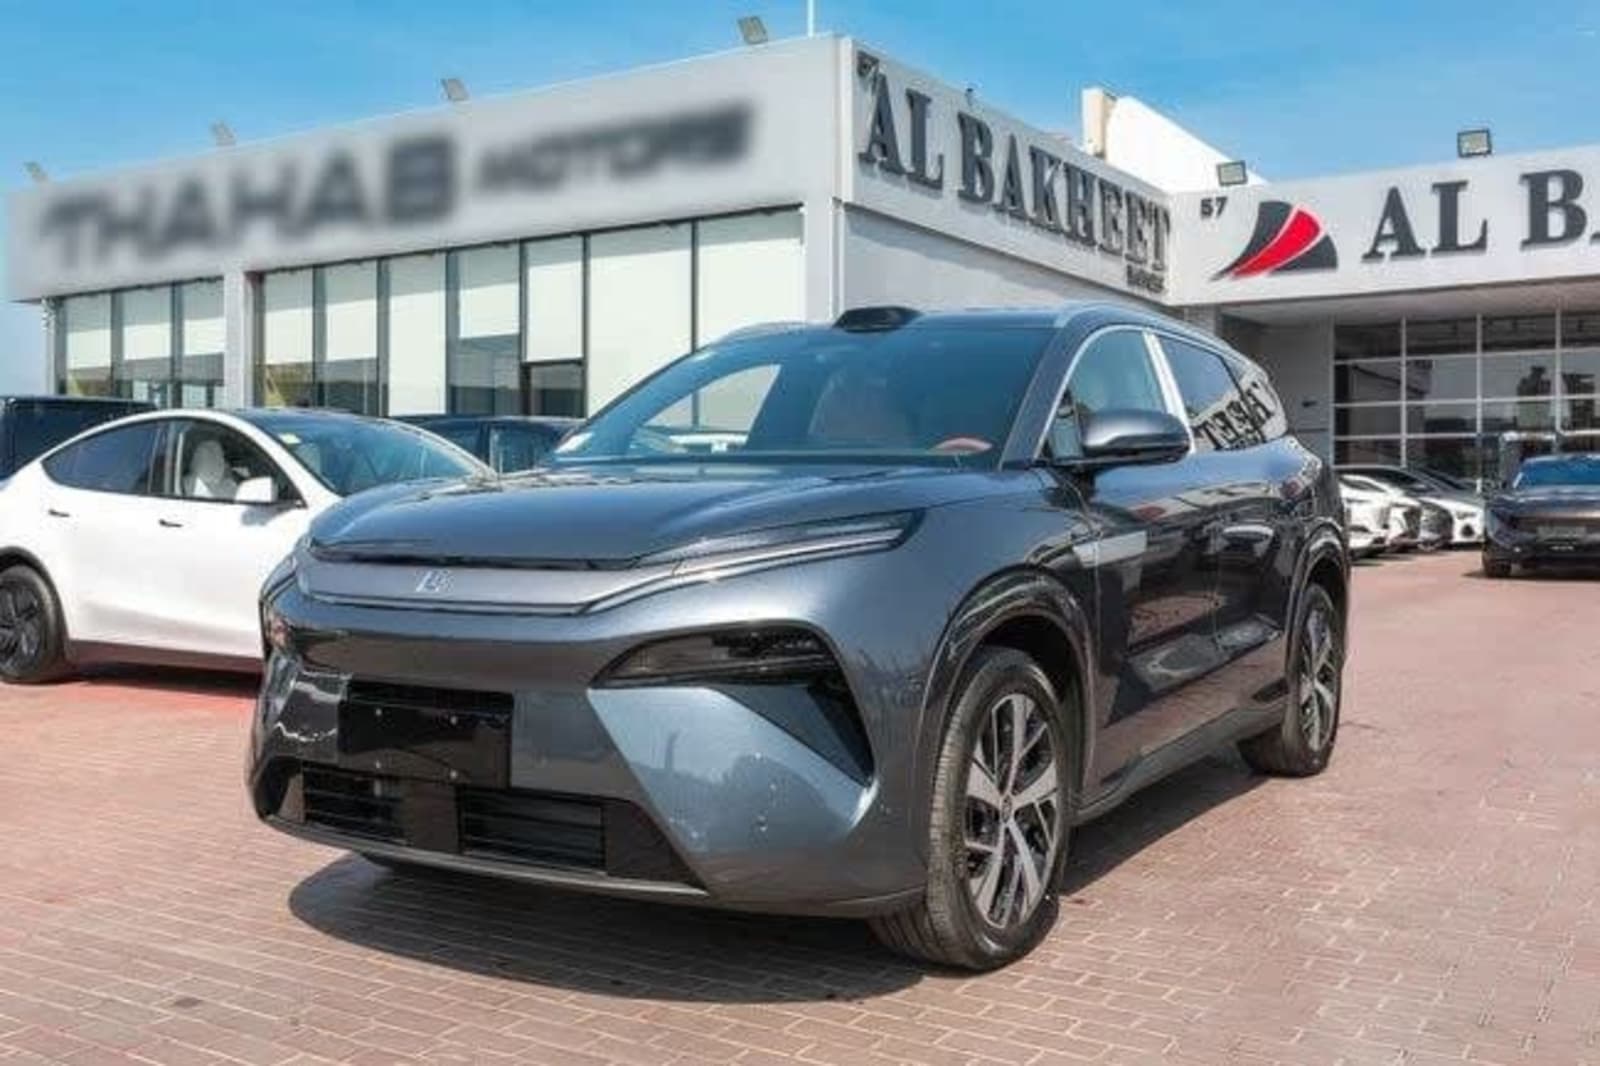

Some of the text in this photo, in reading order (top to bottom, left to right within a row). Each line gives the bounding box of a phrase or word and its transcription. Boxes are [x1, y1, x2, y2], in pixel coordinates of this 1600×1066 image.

[858, 72, 1171, 272] AL BAKHEET
[1200, 196, 1228, 219] 57
[1361, 169, 1600, 262] AL B
